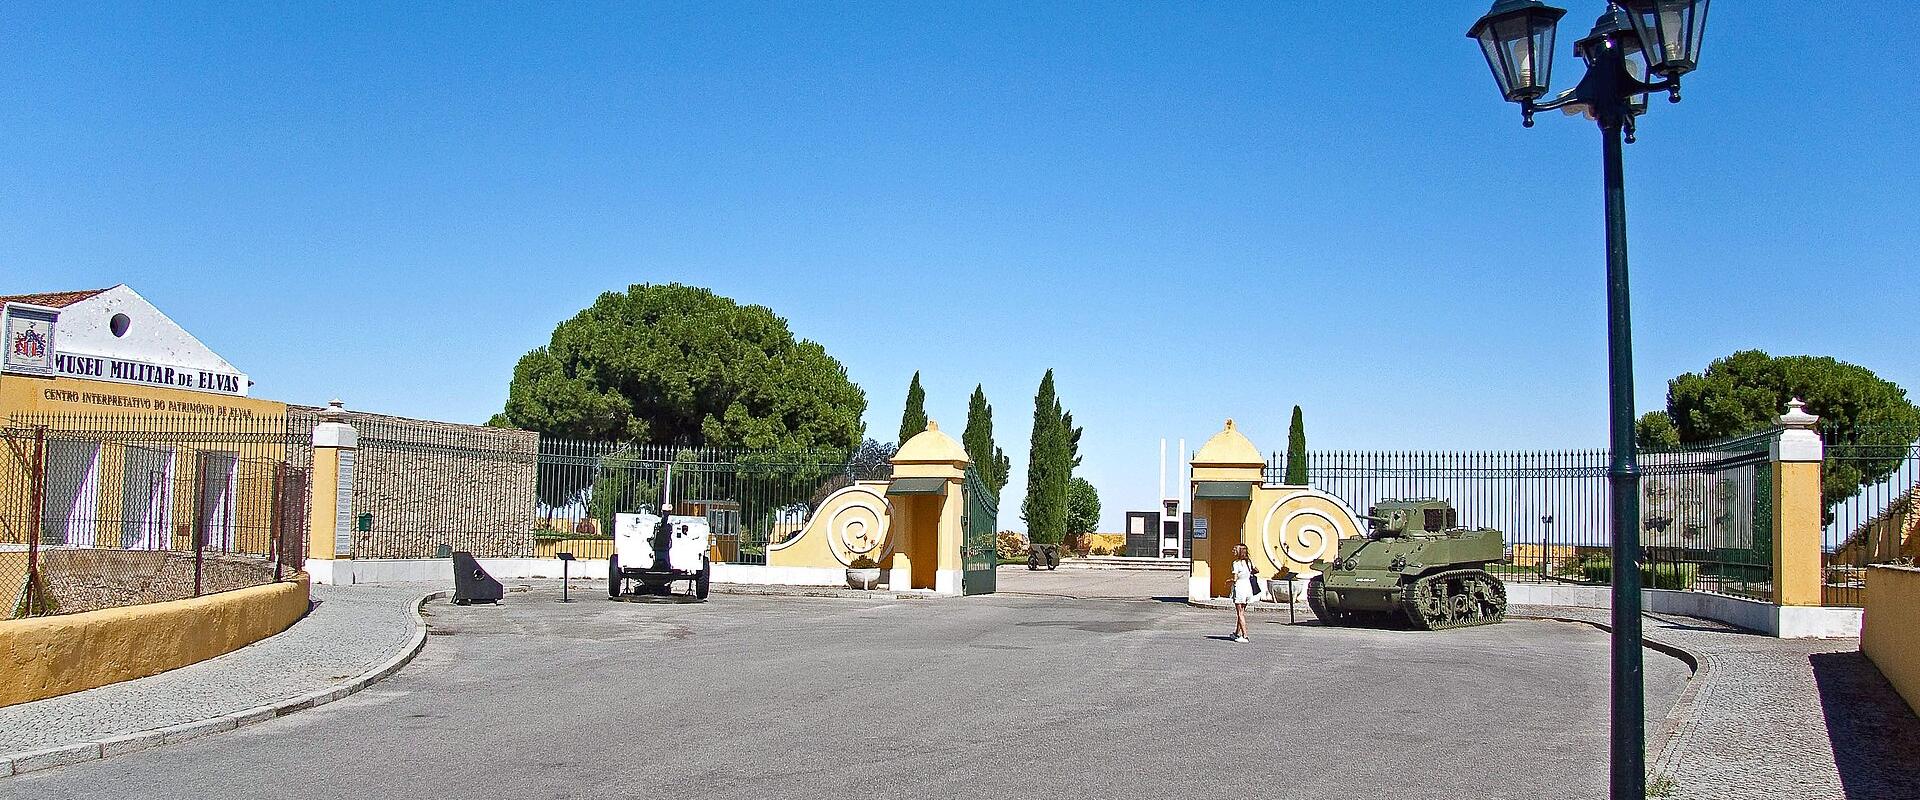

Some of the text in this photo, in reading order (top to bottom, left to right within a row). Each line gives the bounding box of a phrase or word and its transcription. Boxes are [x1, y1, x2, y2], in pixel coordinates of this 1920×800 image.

[55, 353, 239, 392] MUSEU MILITAR DE ELVAS
[44, 388, 252, 419] CENTRO INTERPRETATIVO DO PATRIMÓNIO DE ELVAS
